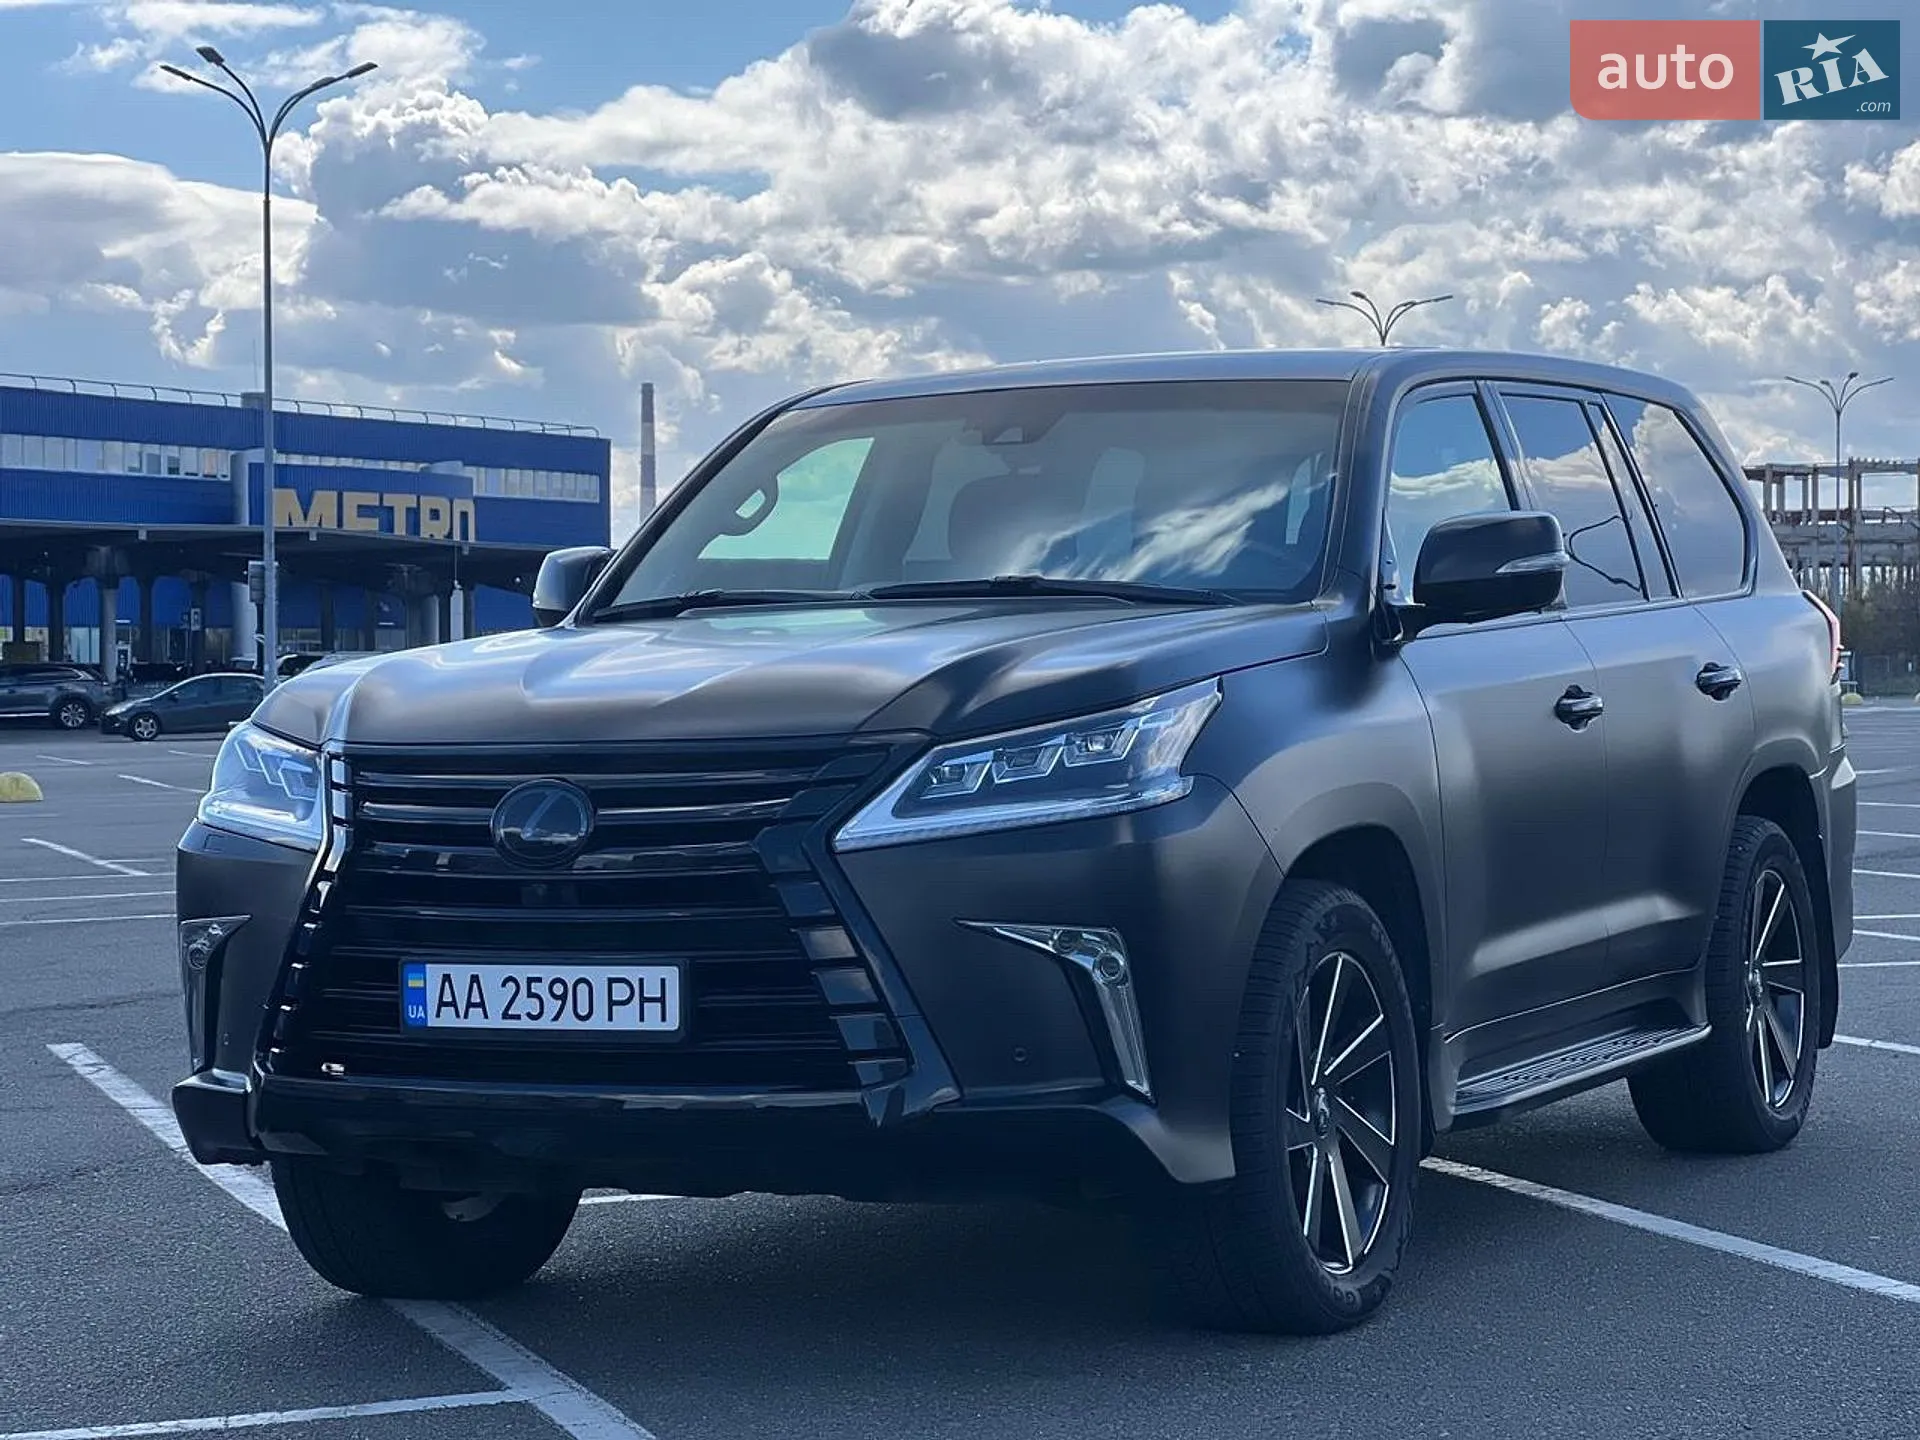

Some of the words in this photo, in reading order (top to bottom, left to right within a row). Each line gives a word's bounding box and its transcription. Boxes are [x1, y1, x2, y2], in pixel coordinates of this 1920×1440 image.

[408, 1004, 426, 1019] UA
[435, 973, 489, 1019] AA
[501, 975, 594, 1022] 2590
[607, 977, 669, 1022] PH
